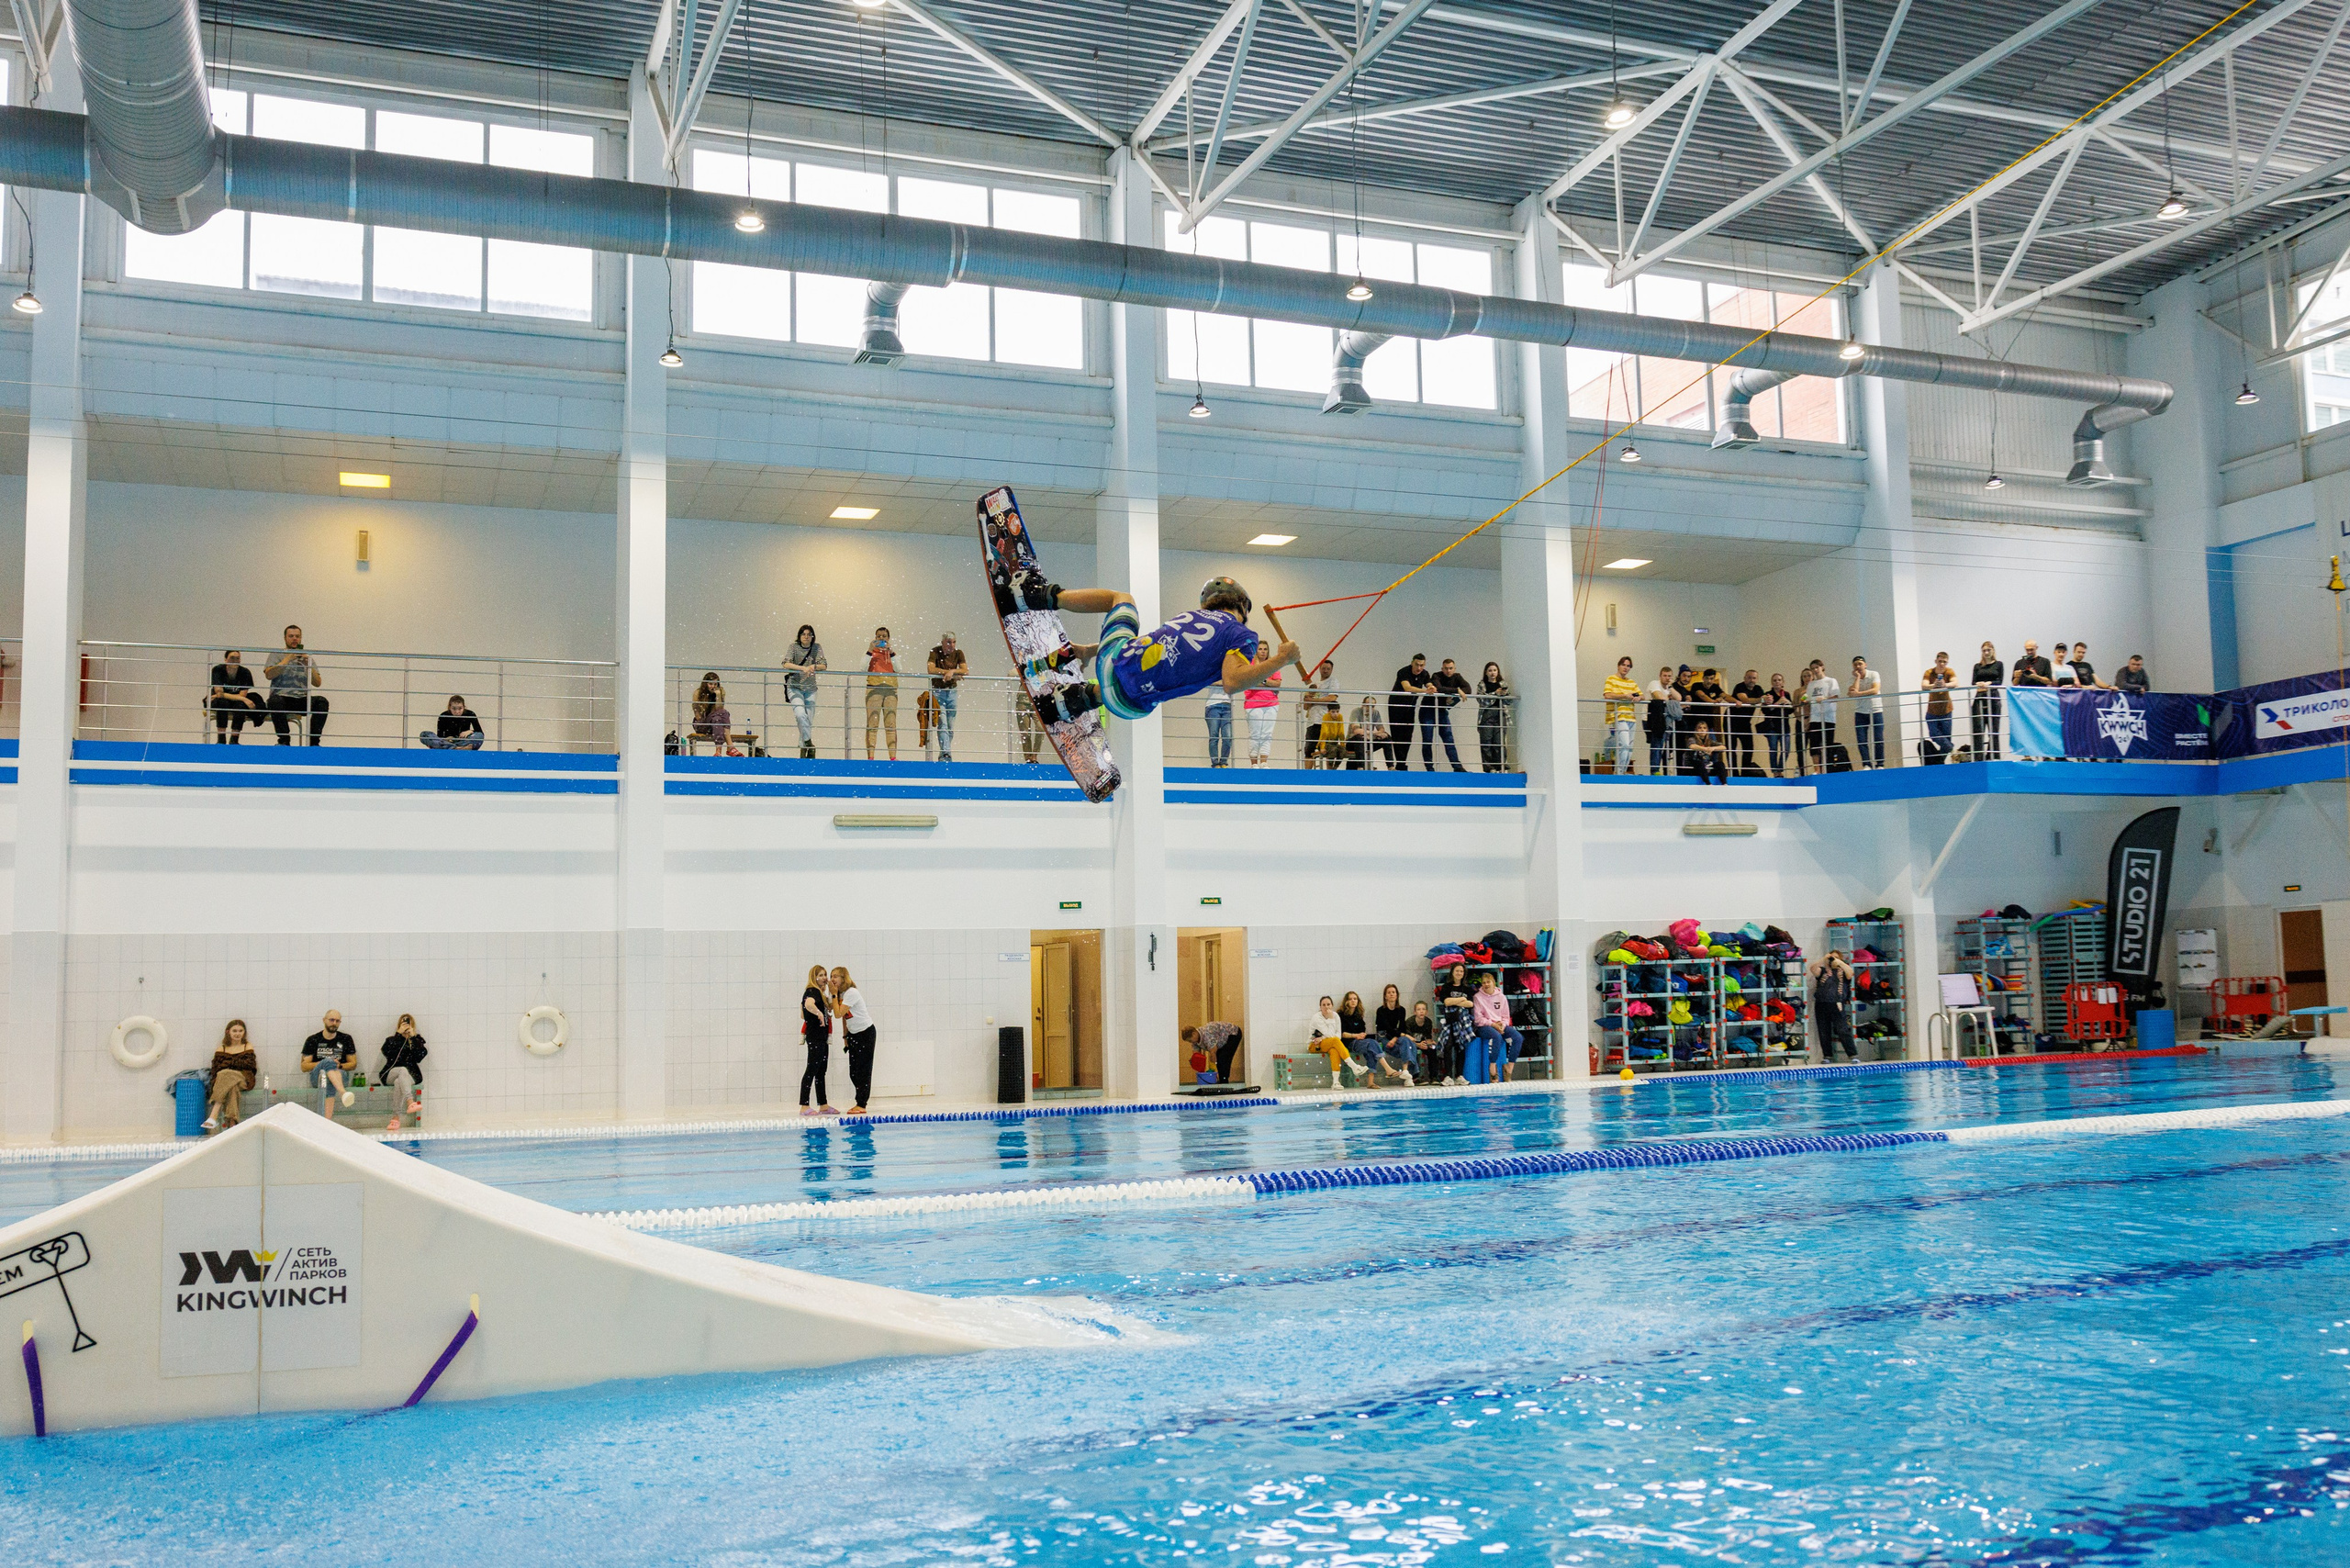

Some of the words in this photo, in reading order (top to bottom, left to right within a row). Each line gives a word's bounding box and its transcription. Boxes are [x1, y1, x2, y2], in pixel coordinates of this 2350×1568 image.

[1164, 611, 1215, 652] 22
[2283, 698, 2349, 718] ТРИКОЛО
[2100, 720, 2144, 738] KWWCH
[2129, 857, 2151, 880] 21
[2121, 886, 2148, 964] STUDIO
[297, 1248, 331, 1258] СЕТЬ
[291, 1258, 338, 1270] АКТИВ
[289, 1269, 347, 1281] ПАРКОВ
[177, 1285, 347, 1313] KINGWINCH
